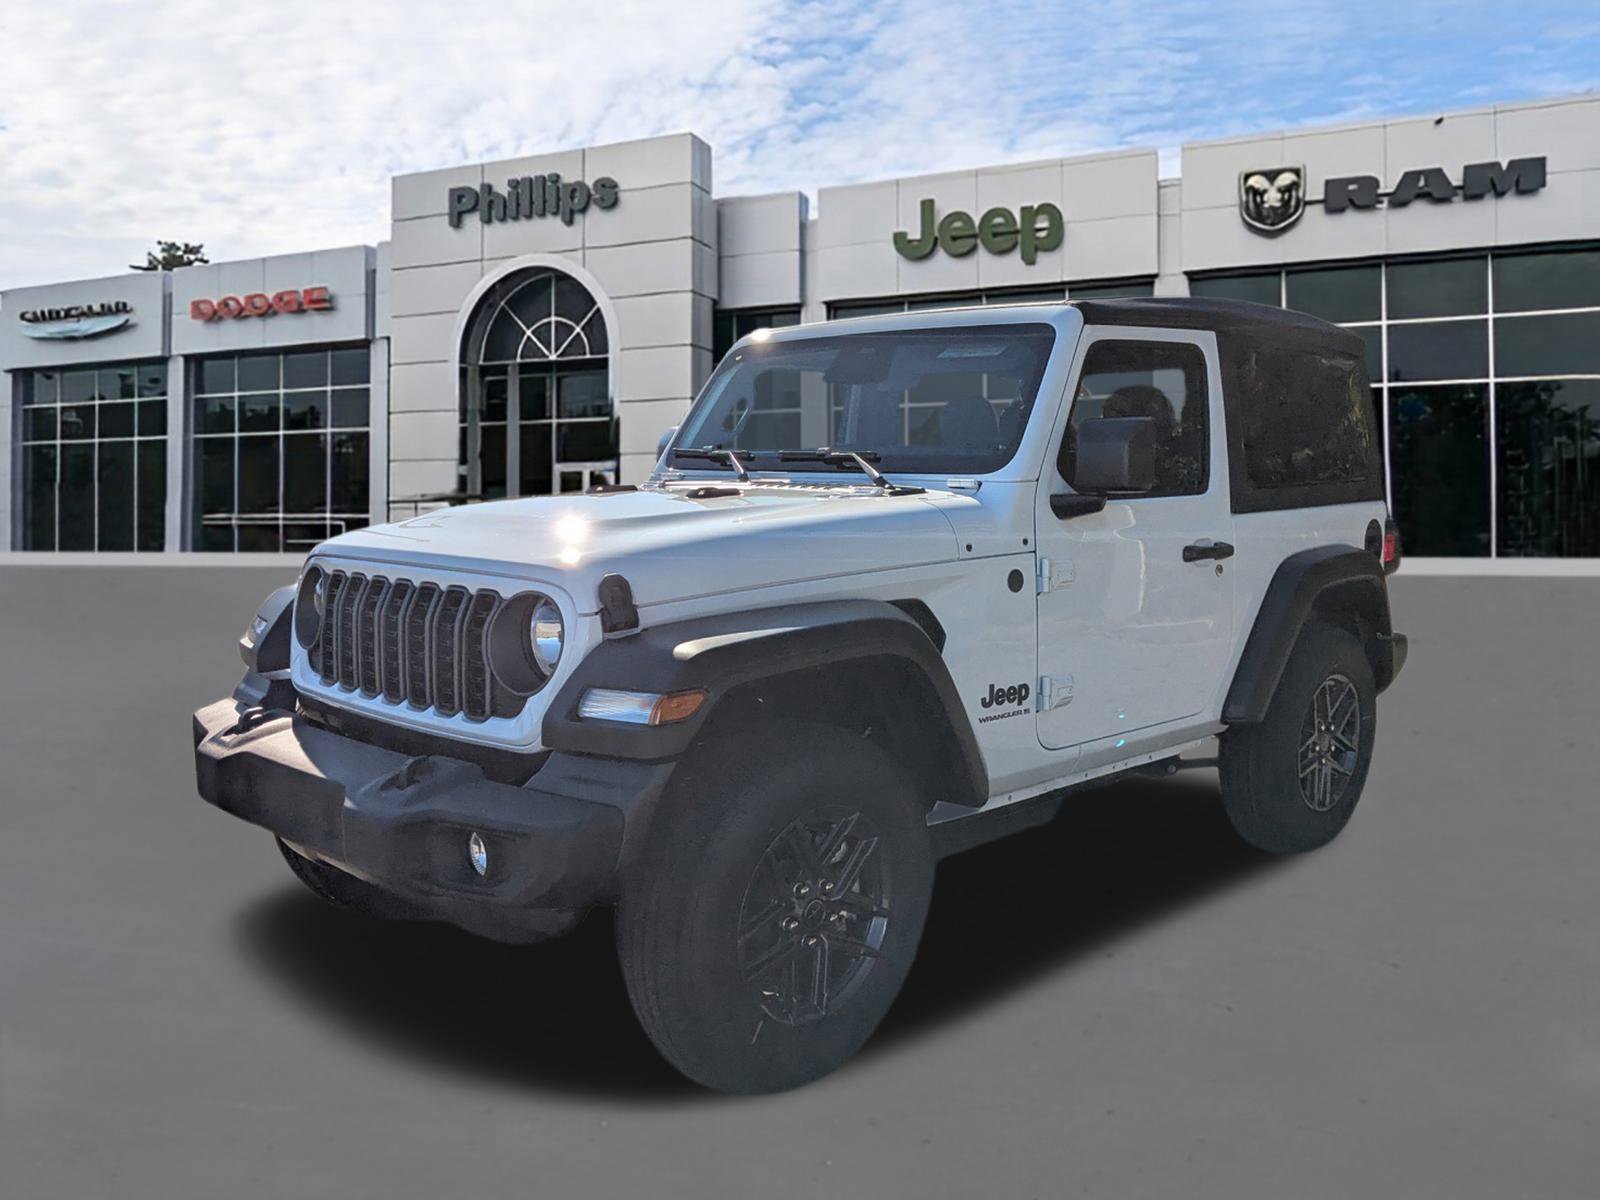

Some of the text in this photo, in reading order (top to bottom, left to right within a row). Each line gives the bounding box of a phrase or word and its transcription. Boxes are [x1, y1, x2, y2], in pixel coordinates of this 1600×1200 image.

[448, 172, 619, 228] Phillips
[1324, 156, 1547, 214] RAM
[893, 198, 1064, 265] Jeep
[191, 286, 333, 322] DODGE
[981, 683, 1030, 708] Jeep
